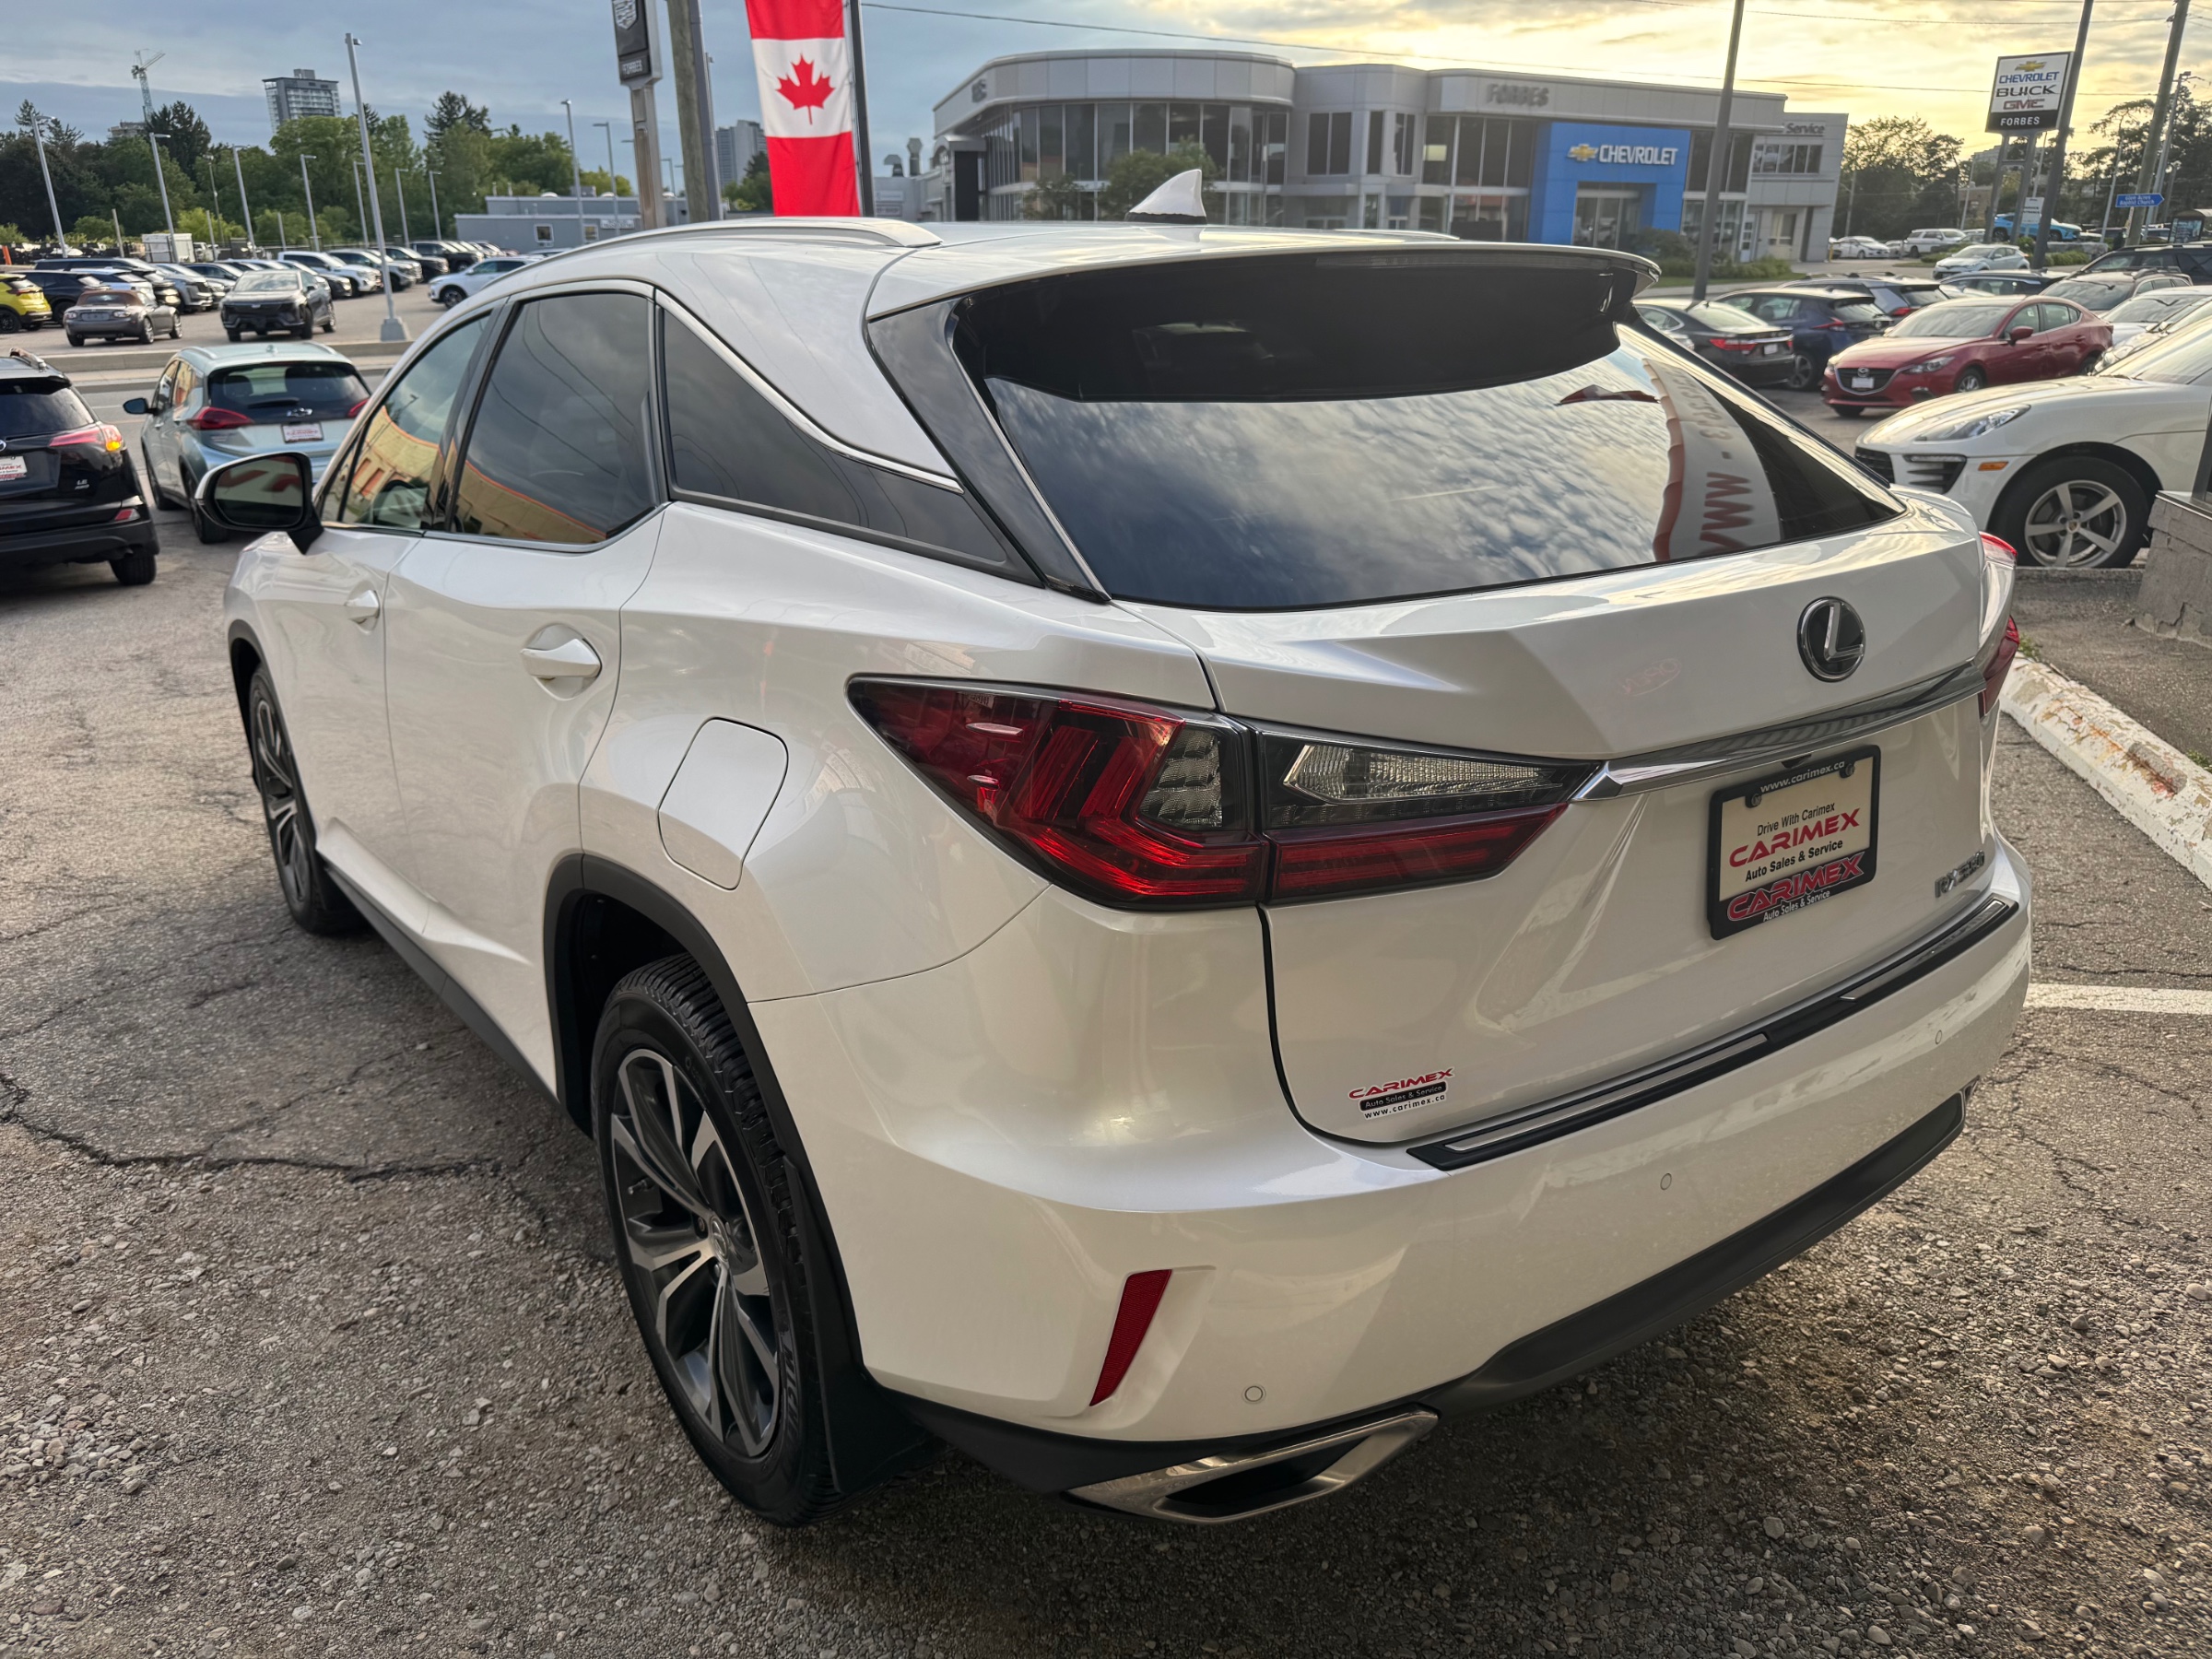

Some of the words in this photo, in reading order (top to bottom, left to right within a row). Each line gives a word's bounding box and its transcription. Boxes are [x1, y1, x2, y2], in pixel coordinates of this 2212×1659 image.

[1998, 72, 2060, 84] CHEVROLET
[1486, 83, 1549, 107] FORBES
[1995, 85, 2057, 97] BUICK
[2003, 99, 2045, 110] GMC
[1786, 123, 1825, 135] Service
[2000, 116, 2040, 126] FORBES
[1599, 145, 1678, 165] CHEVROLET
[1759, 761, 1845, 794] www.carimex.ca
[1757, 821, 1779, 836] Drive
[1782, 813, 1799, 828] With
[1802, 803, 1835, 820] Carimex
[1729, 807, 1860, 867] CARIMEX
[1746, 866, 1767, 882] Auto
[1770, 855, 1795, 872] Sales
[1798, 851, 1806, 862] &
[1808, 840, 1842, 858] Service
[1728, 853, 1863, 920] CARIMEX
[1763, 909, 1779, 922] Auto
[1781, 901, 1798, 915] Sales
[1800, 899, 1806, 907] &
[1806, 889, 1830, 904] Service
[1348, 1068, 1453, 1099] CARIMEX
[1364, 1095, 1445, 1119] www.carimex.ca
[1365, 1099, 1383, 1109] Auto
[1385, 1094, 1406, 1104] Sales
[1417, 1085, 1442, 1097] Service
